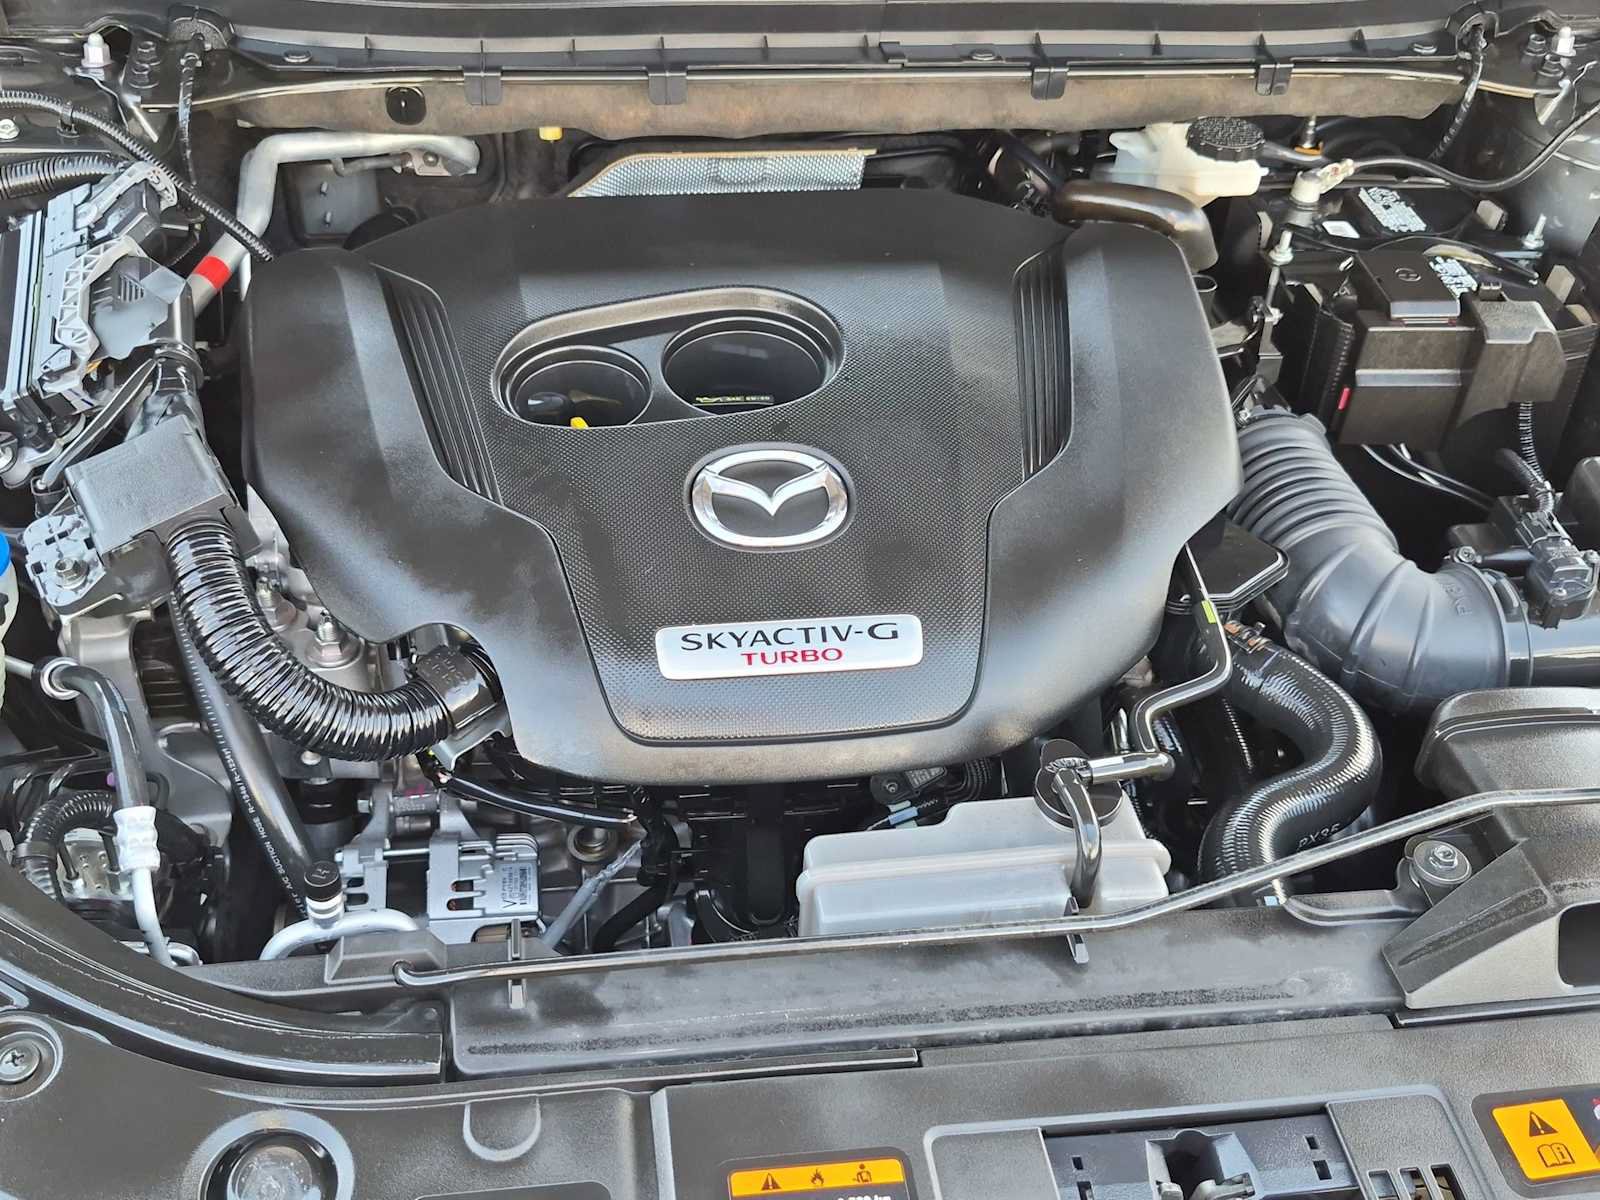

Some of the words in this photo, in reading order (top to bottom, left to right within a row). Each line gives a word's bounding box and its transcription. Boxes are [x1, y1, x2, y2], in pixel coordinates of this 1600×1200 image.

[681, 622, 899, 651] SKYACTIV-G
[740, 648, 843, 666] TURBO
[253, 816, 268, 839] HOSE
[264, 841, 285, 874] SUCTION
